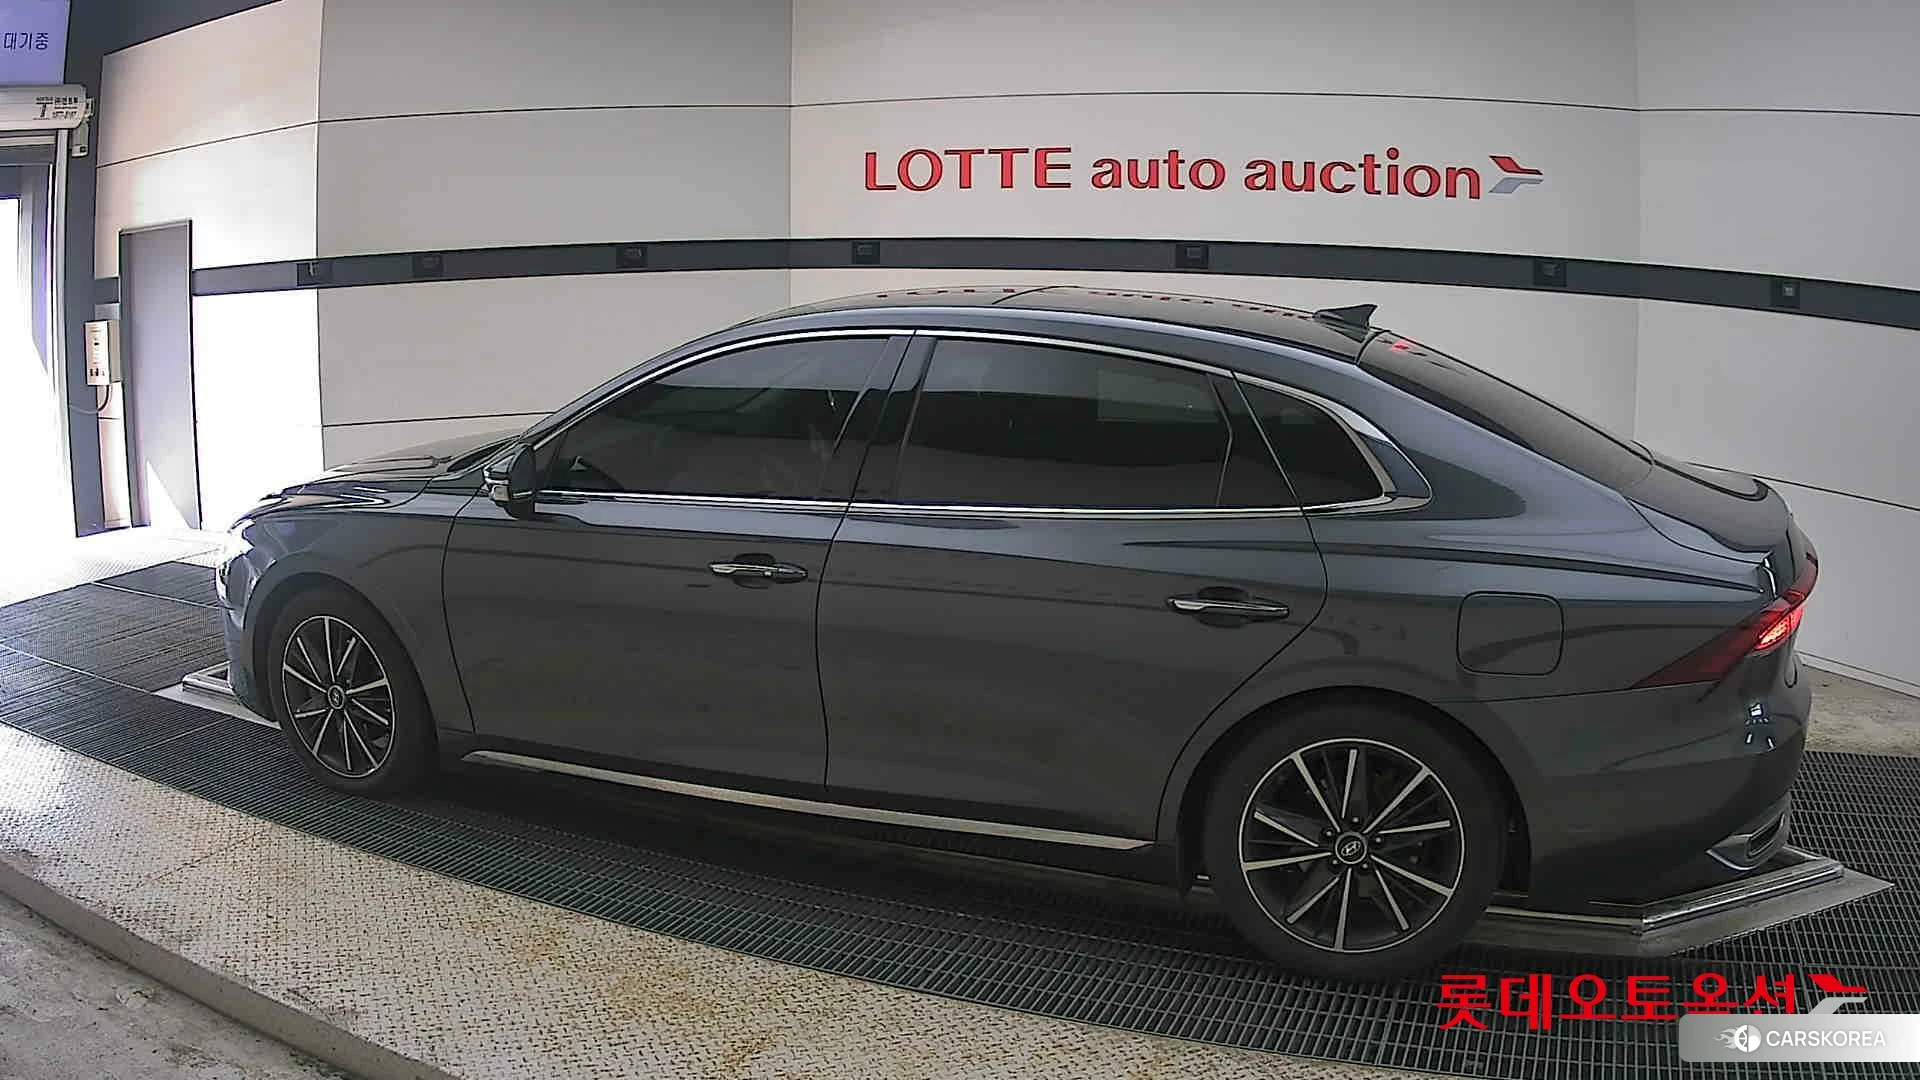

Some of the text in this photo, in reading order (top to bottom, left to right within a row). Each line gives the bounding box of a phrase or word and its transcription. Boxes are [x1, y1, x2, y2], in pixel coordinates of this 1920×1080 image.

[3, 32, 49, 51] 대기중
[864, 146, 1482, 200] LOTTE auto auction
